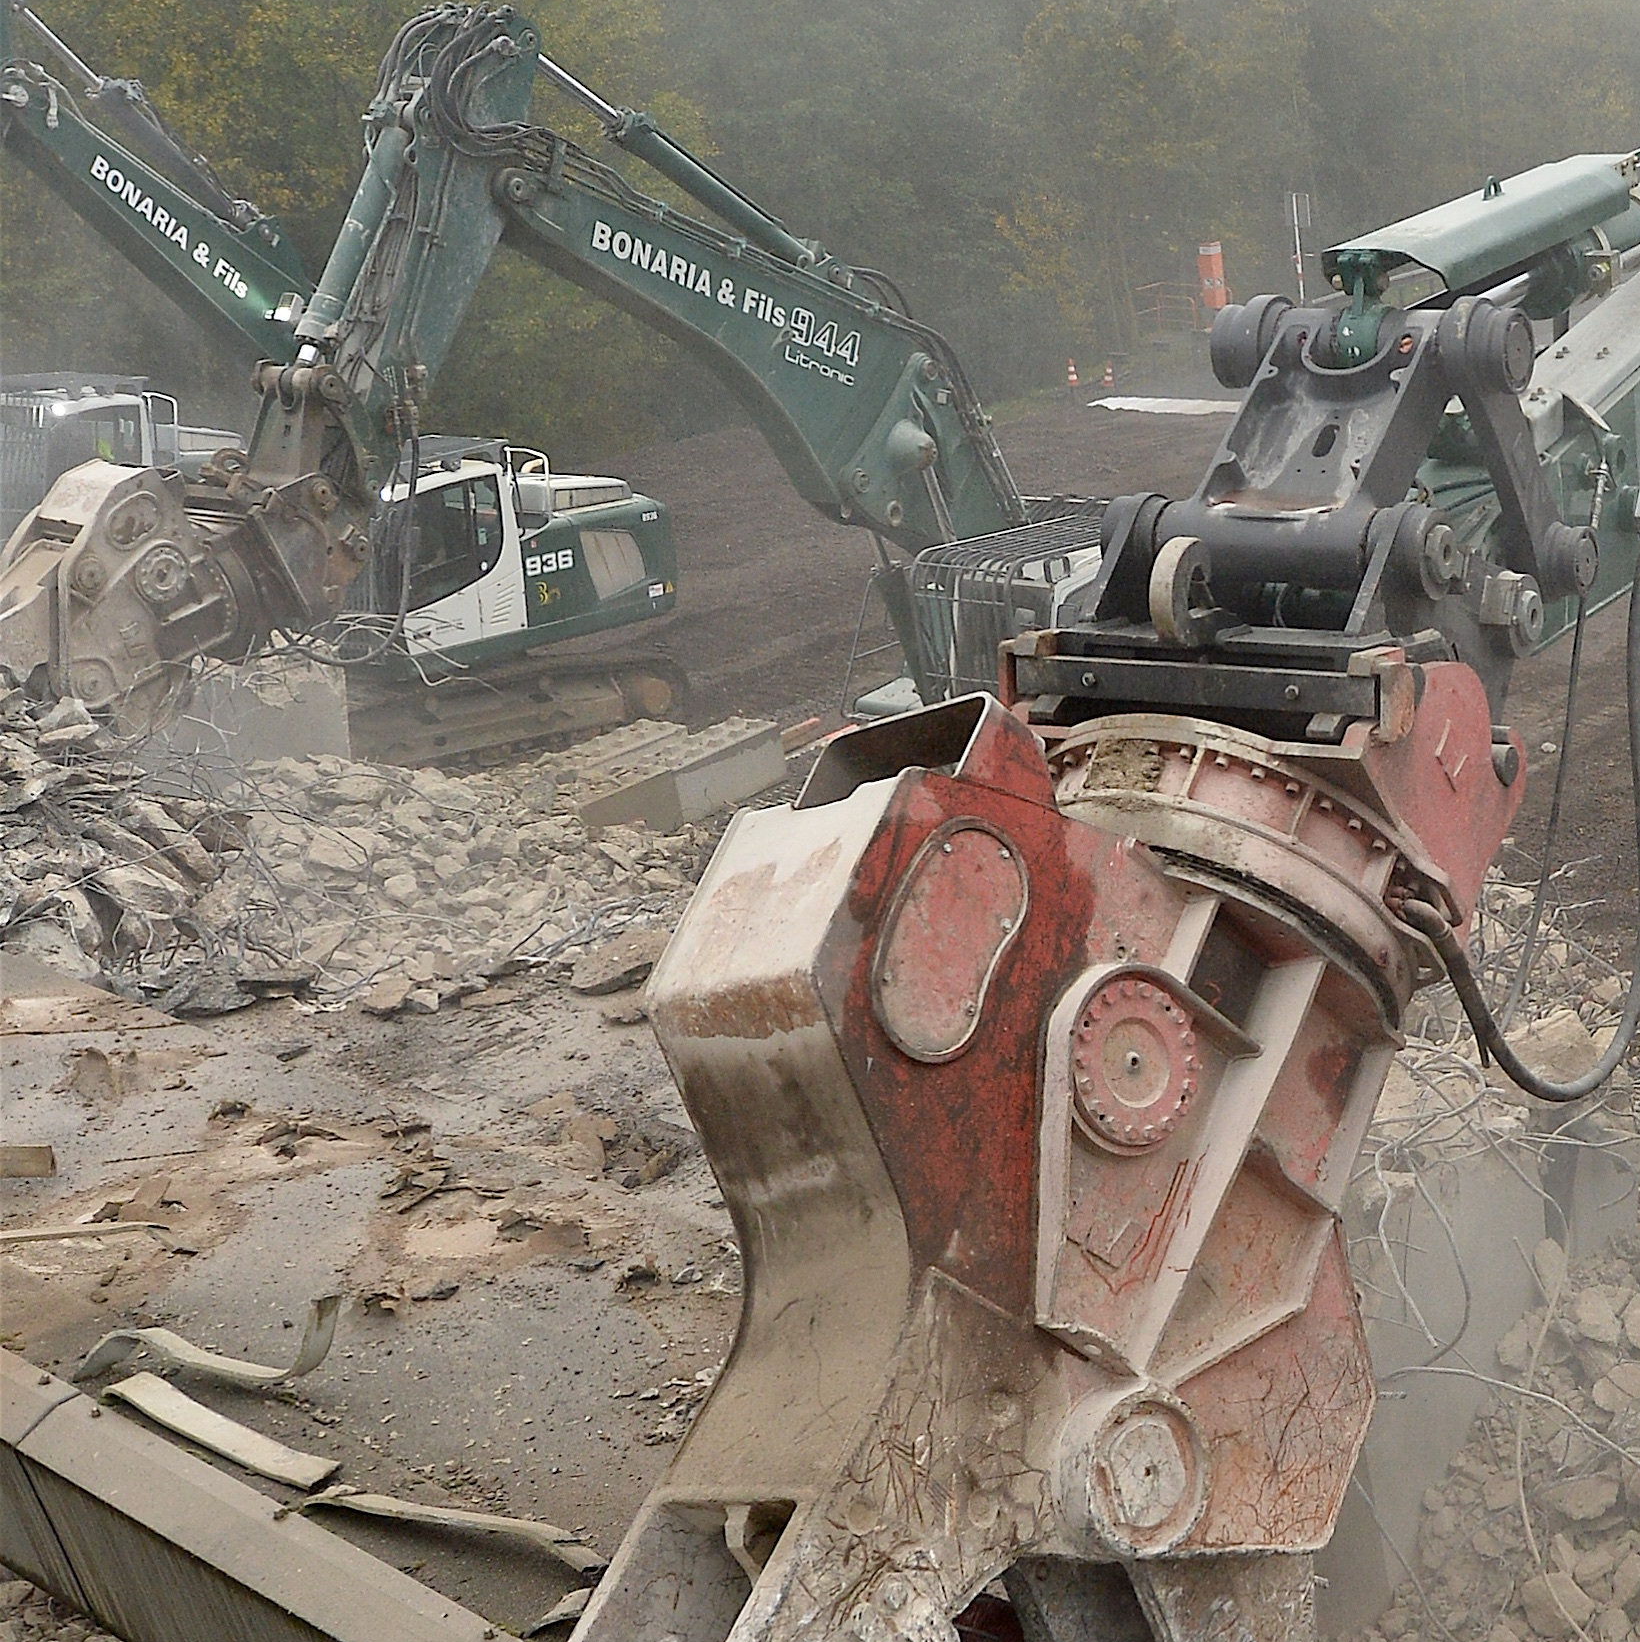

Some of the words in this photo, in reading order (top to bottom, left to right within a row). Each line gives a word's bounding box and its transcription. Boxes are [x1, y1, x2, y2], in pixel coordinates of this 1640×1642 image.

[90, 155, 189, 251] BONARIA
[192, 242, 210, 268] &
[213, 257, 249, 299] Fils
[591, 220, 711, 297] BONARIA
[717, 278, 736, 307] &
[742, 288, 786, 328] Fils
[785, 345, 855, 386] Litronic
[791, 307, 861, 366] 944
[525, 549, 574, 577] 936
